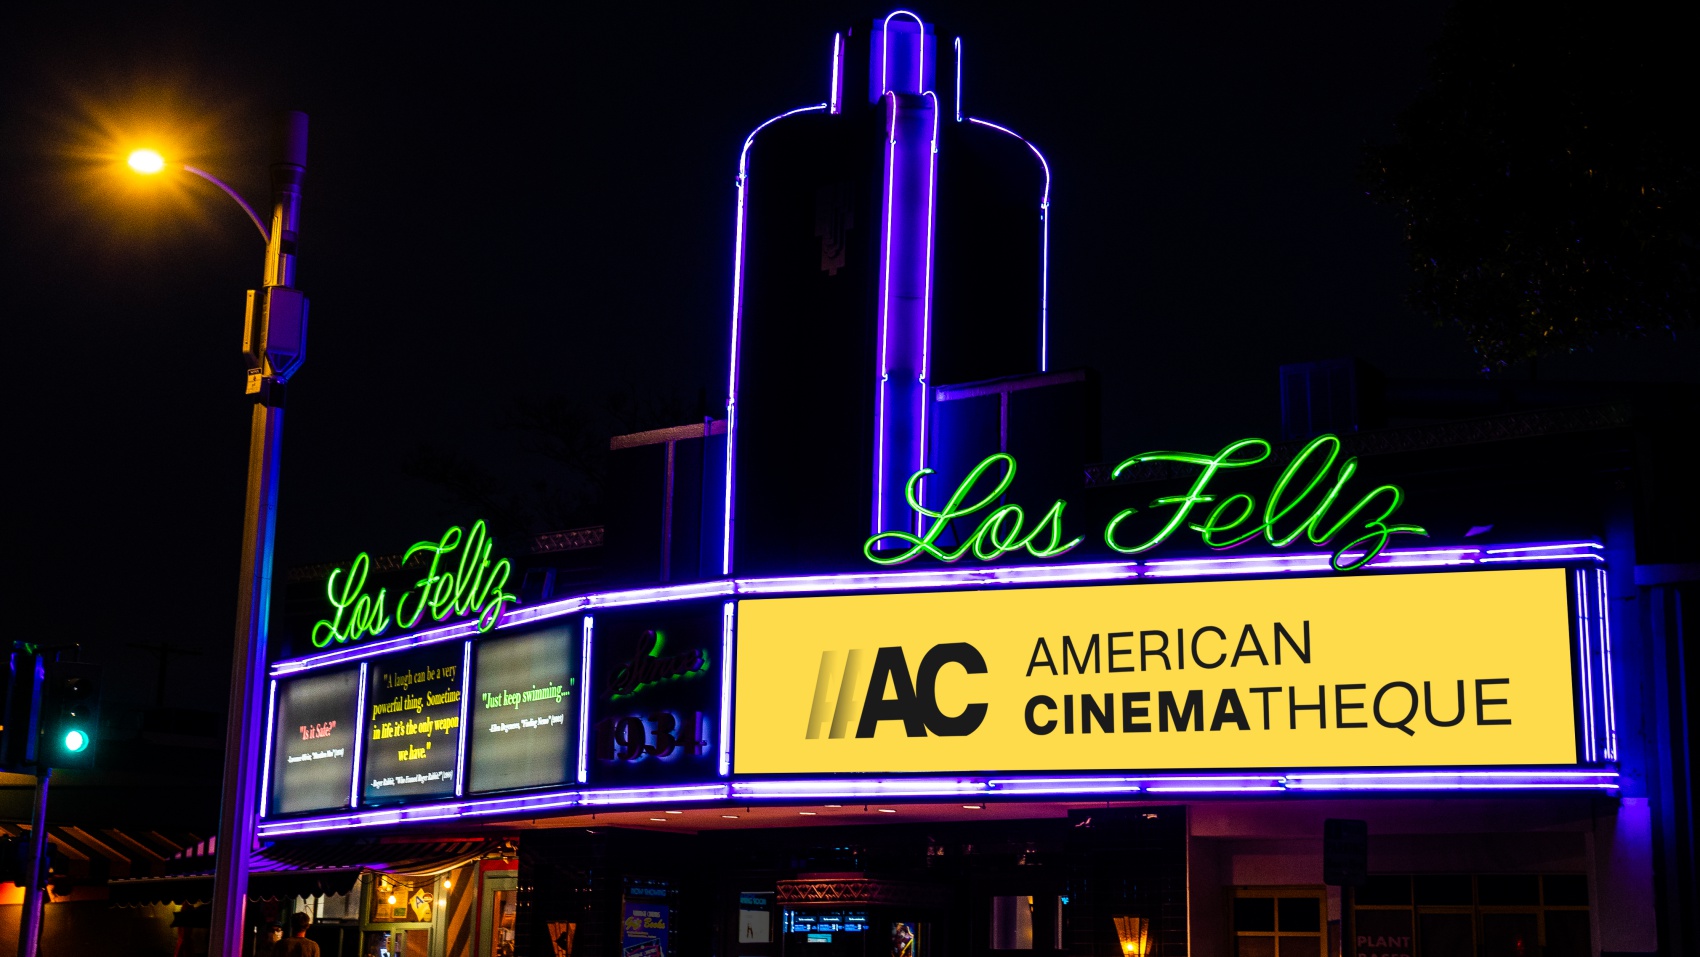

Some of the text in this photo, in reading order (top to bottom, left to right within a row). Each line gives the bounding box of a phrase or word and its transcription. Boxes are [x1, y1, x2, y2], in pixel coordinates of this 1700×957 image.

[864, 433, 1430, 572] Los Feliz
[312, 519, 517, 648] Los Feliz
[1025, 620, 1312, 677] AMERICAN
[394, 669, 413, 691] laugh
[413, 671, 426, 683] can
[426, 665, 435, 681] be
[436, 668, 441, 679] a
[442, 665, 457, 682] very
[372, 696, 403, 720] powerful
[404, 694, 424, 714] thing.
[482, 692, 502, 709] "Just
[503, 689, 521, 710] keep
[1024, 677, 1512, 738] CINEMATHEQUE
[309, 724, 316, 740] it
[372, 716, 460, 740] in life it's the only weapon
[593, 710, 709, 761] 1934
[398, 741, 432, 761] we have."
[1357, 935, 1411, 948] PLANT
